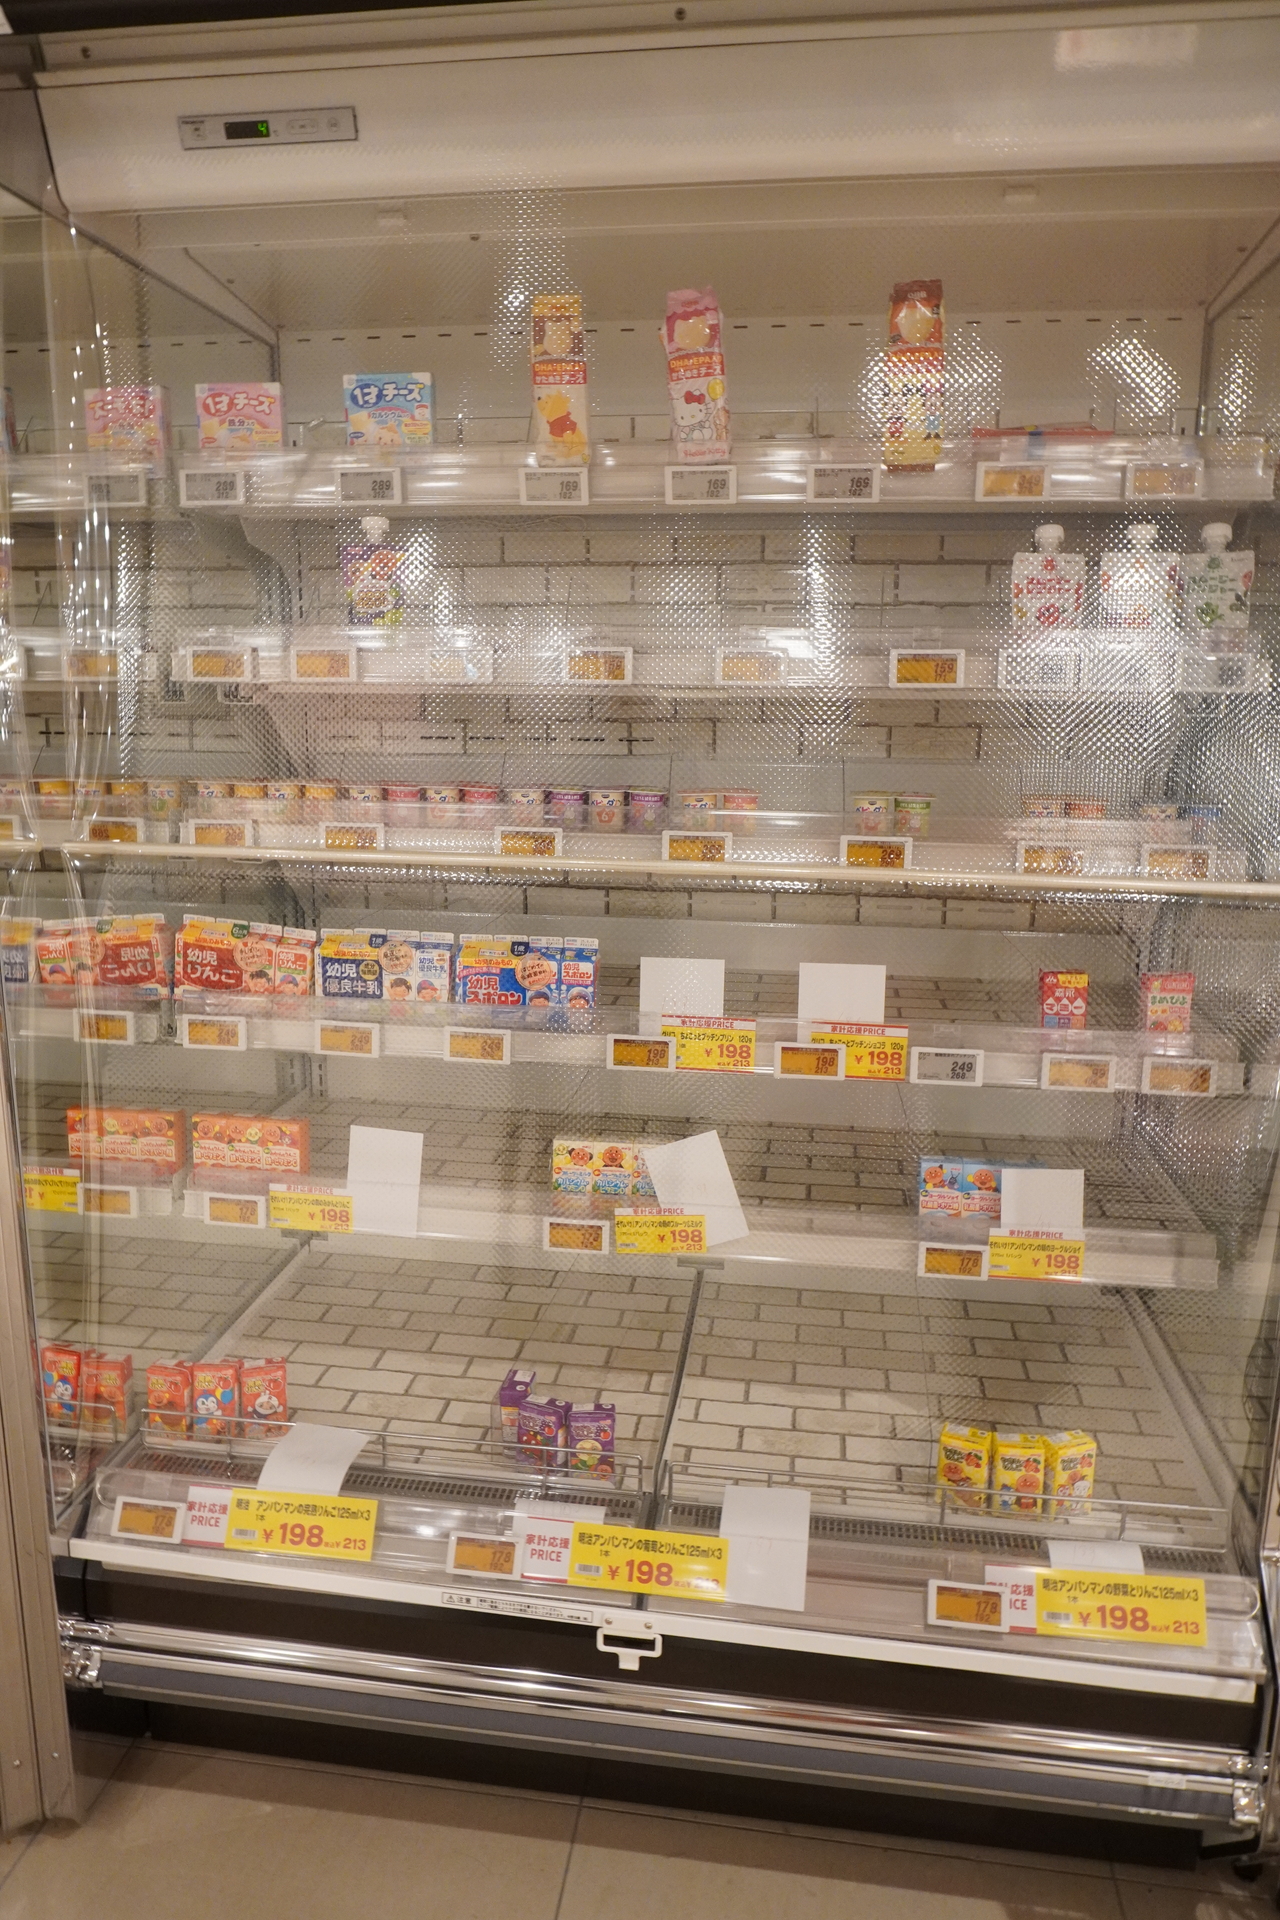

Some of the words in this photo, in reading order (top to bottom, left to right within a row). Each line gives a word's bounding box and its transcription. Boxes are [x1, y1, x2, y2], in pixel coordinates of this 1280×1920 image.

[257, 122, 267, 135] 4
[371, 480, 392, 491] 289
[559, 480, 578, 492] 169
[707, 479, 727, 490] 169
[934, 662, 954, 674] 159
[881, 849, 902, 860] 269
[187, 948, 218, 965] 幼児
[279, 951, 295, 961] 幼児
[418, 957, 434, 965] 幼児
[279, 960, 305, 970] りんご
[325, 962, 357, 977] 幼児
[563, 962, 580, 971] 幼児
[187, 964, 240, 983] りんご
[562, 971, 592, 979] スポロン
[325, 978, 381, 995] 優良牛乳
[467, 976, 499, 990] 幼児
[466, 990, 522, 1005] スポロン
[830, 1025, 886, 1035] 家計応援PRICE
[738, 1035, 753, 1044] 120g
[705, 1048, 713, 1057] ¥
[717, 1043, 751, 1060] 198
[890, 1042, 904, 1051] 120g
[646, 1048, 666, 1059] 198
[854, 1054, 864, 1064] ¥
[868, 1050, 903, 1067] 198
[732, 1059, 751, 1067] 213
[816, 1055, 836, 1067] 198
[951, 1061, 973, 1073] 249
[814, 1066, 829, 1074] 213
[883, 1066, 901, 1075] 213
[950, 1071, 966, 1080] 268
[308, 1212, 316, 1220] ¥
[319, 1207, 350, 1223] 198
[334, 1222, 350, 1231] 213
[658, 1234, 666, 1243] ¥
[670, 1229, 703, 1243] 198
[1009, 1229, 1064, 1239] 家計応援PRICE
[959, 1256, 979, 1268] 178
[1032, 1257, 1041, 1267] ¥
[1045, 1253, 1080, 1269] 198
[186, 1500, 229, 1515] 家計応援
[190, 1514, 221, 1528] PRICE
[262, 1529, 274, 1543] ¥
[279, 1522, 325, 1548] 198
[342, 1537, 367, 1551] 213
[525, 1533, 570, 1550] 家計応援
[491, 1551, 512, 1563] 178
[530, 1548, 563, 1562] PRICE
[599, 1549, 611, 1558] 1本
[606, 1565, 620, 1581] ¥
[625, 1559, 674, 1587] 198
[456, 1596, 472, 1605] 注意
[976, 1600, 998, 1614] 178
[1078, 1611, 1092, 1627] ¥
[1096, 1604, 1150, 1632] 198
[1172, 1619, 1201, 1635] 213
